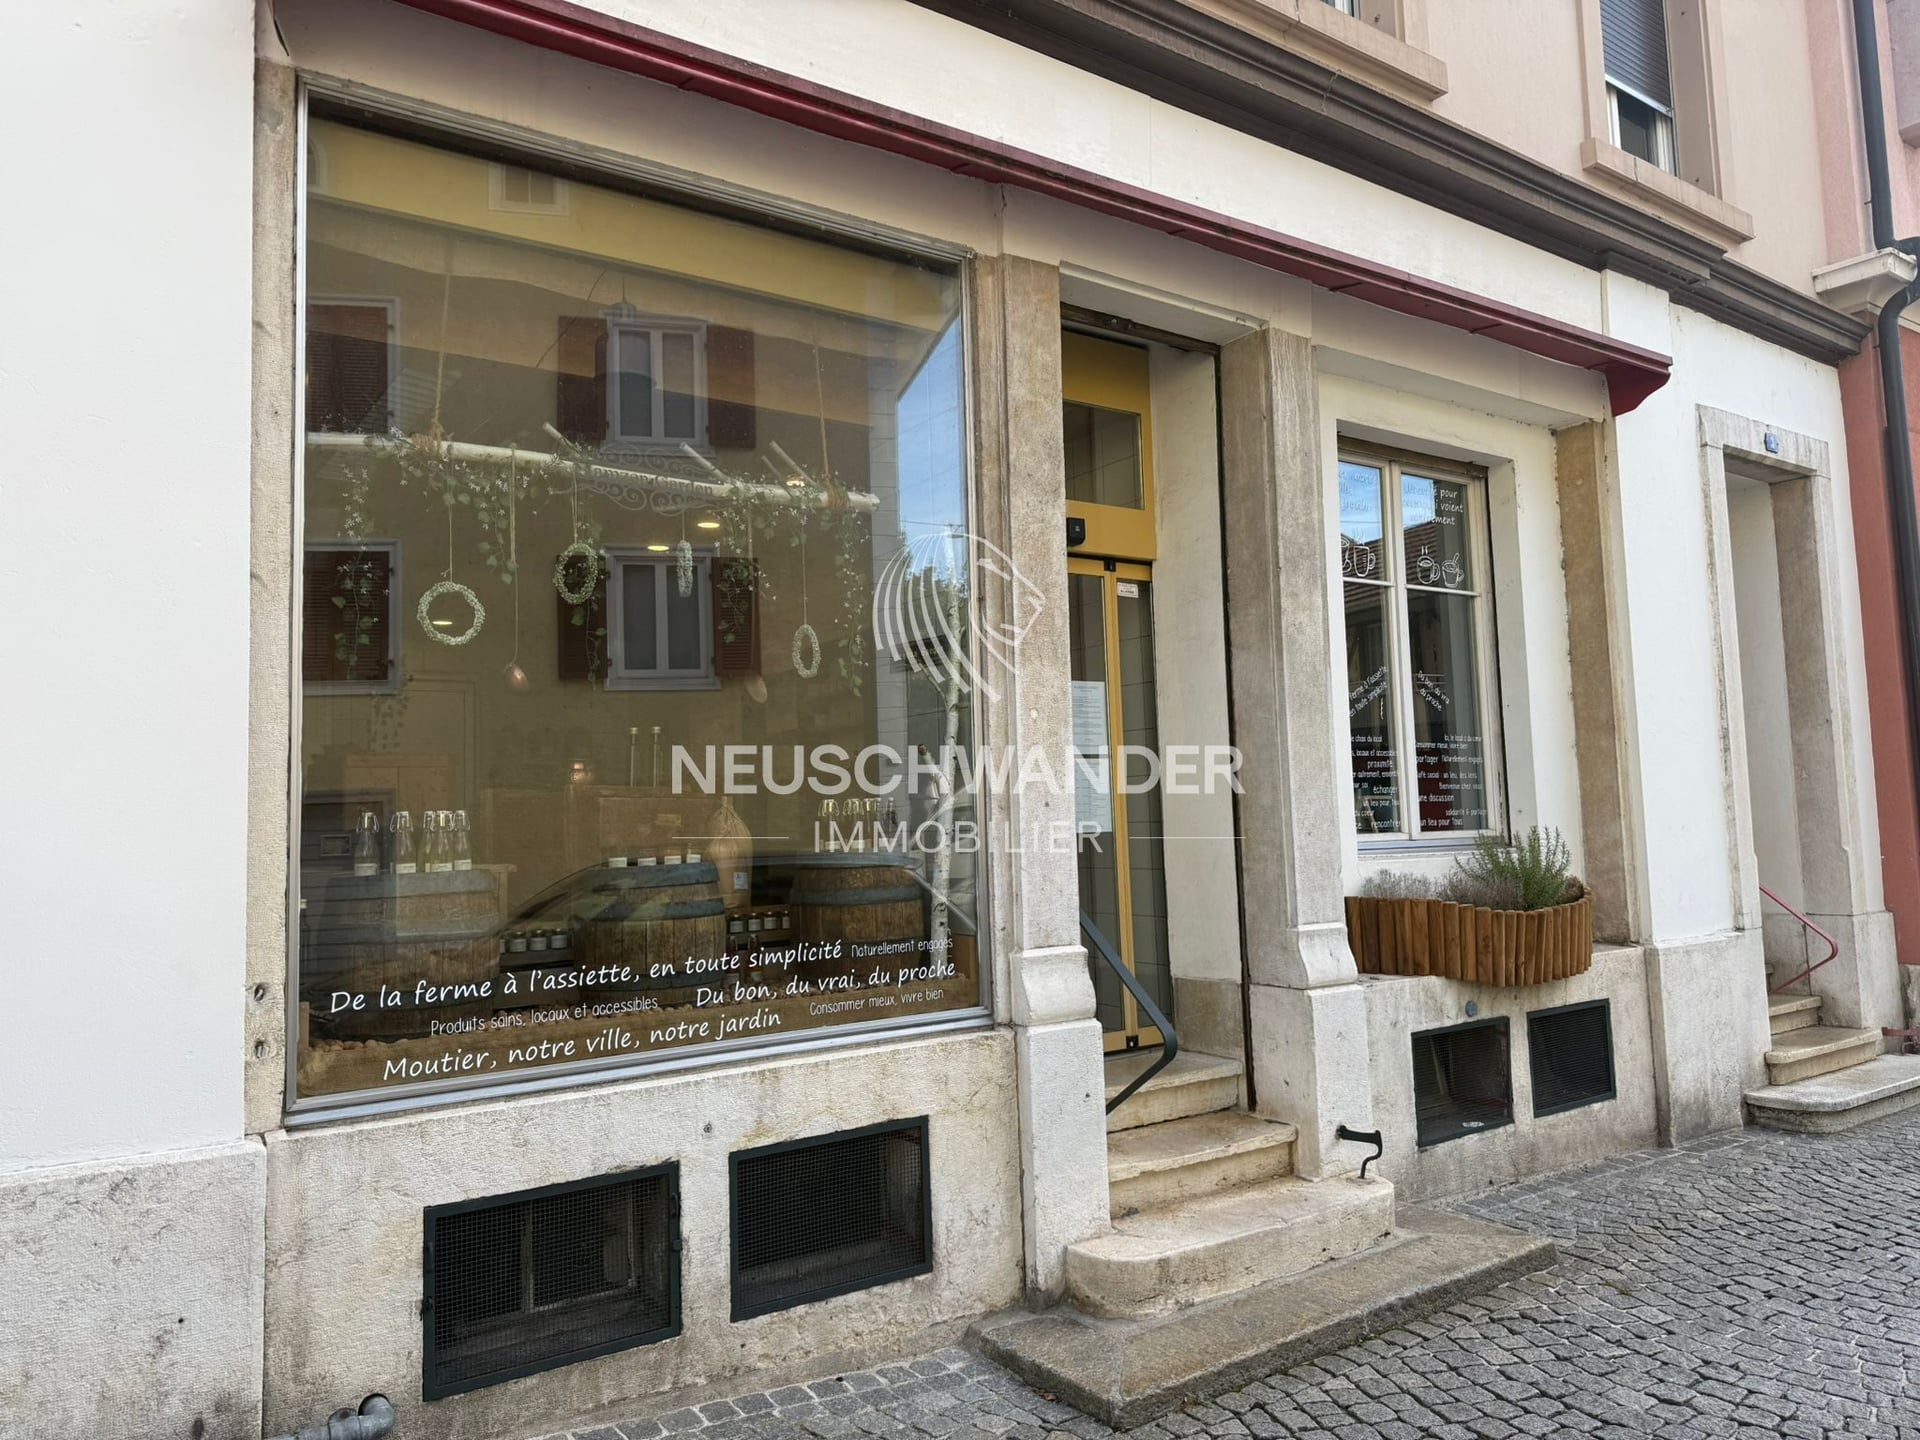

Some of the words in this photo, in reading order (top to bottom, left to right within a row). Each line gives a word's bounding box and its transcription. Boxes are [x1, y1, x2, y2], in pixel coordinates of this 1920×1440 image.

[1440, 489, 1458, 500] pour
[1440, 502, 1464, 513] voient
[850, 937, 915, 958] Naturellement
[330, 991, 366, 1014] De
[379, 984, 402, 1008] la
[414, 978, 492, 1005] ferme
[503, 972, 519, 995] à
[650, 960, 677, 979] en
[685, 950, 741, 975] toute
[749, 938, 843, 972] simplicité
[695, 986, 725, 1008] Du
[734, 978, 777, 1002] bon,
[786, 973, 810, 997] du
[817, 969, 862, 992] vrai,
[868, 965, 890, 987] du
[898, 958, 957, 986] proche
[430, 1014, 486, 1037] Produits
[490, 1013, 528, 1030] sains,
[531, 1006, 570, 1024] locaux
[573, 1003, 588, 1019] et
[592, 994, 659, 1016] accessibles
[809, 997, 865, 1017] Consommer
[868, 993, 900, 1009] mieux,
[900, 990, 923, 1004] vivre
[924, 986, 944, 1002] bien
[383, 1050, 498, 1081] Moutier,
[508, 1037, 576, 1065] notre
[586, 1026, 641, 1052] ville,
[649, 1017, 710, 1044] notre
[715, 1008, 782, 1042] jardin
